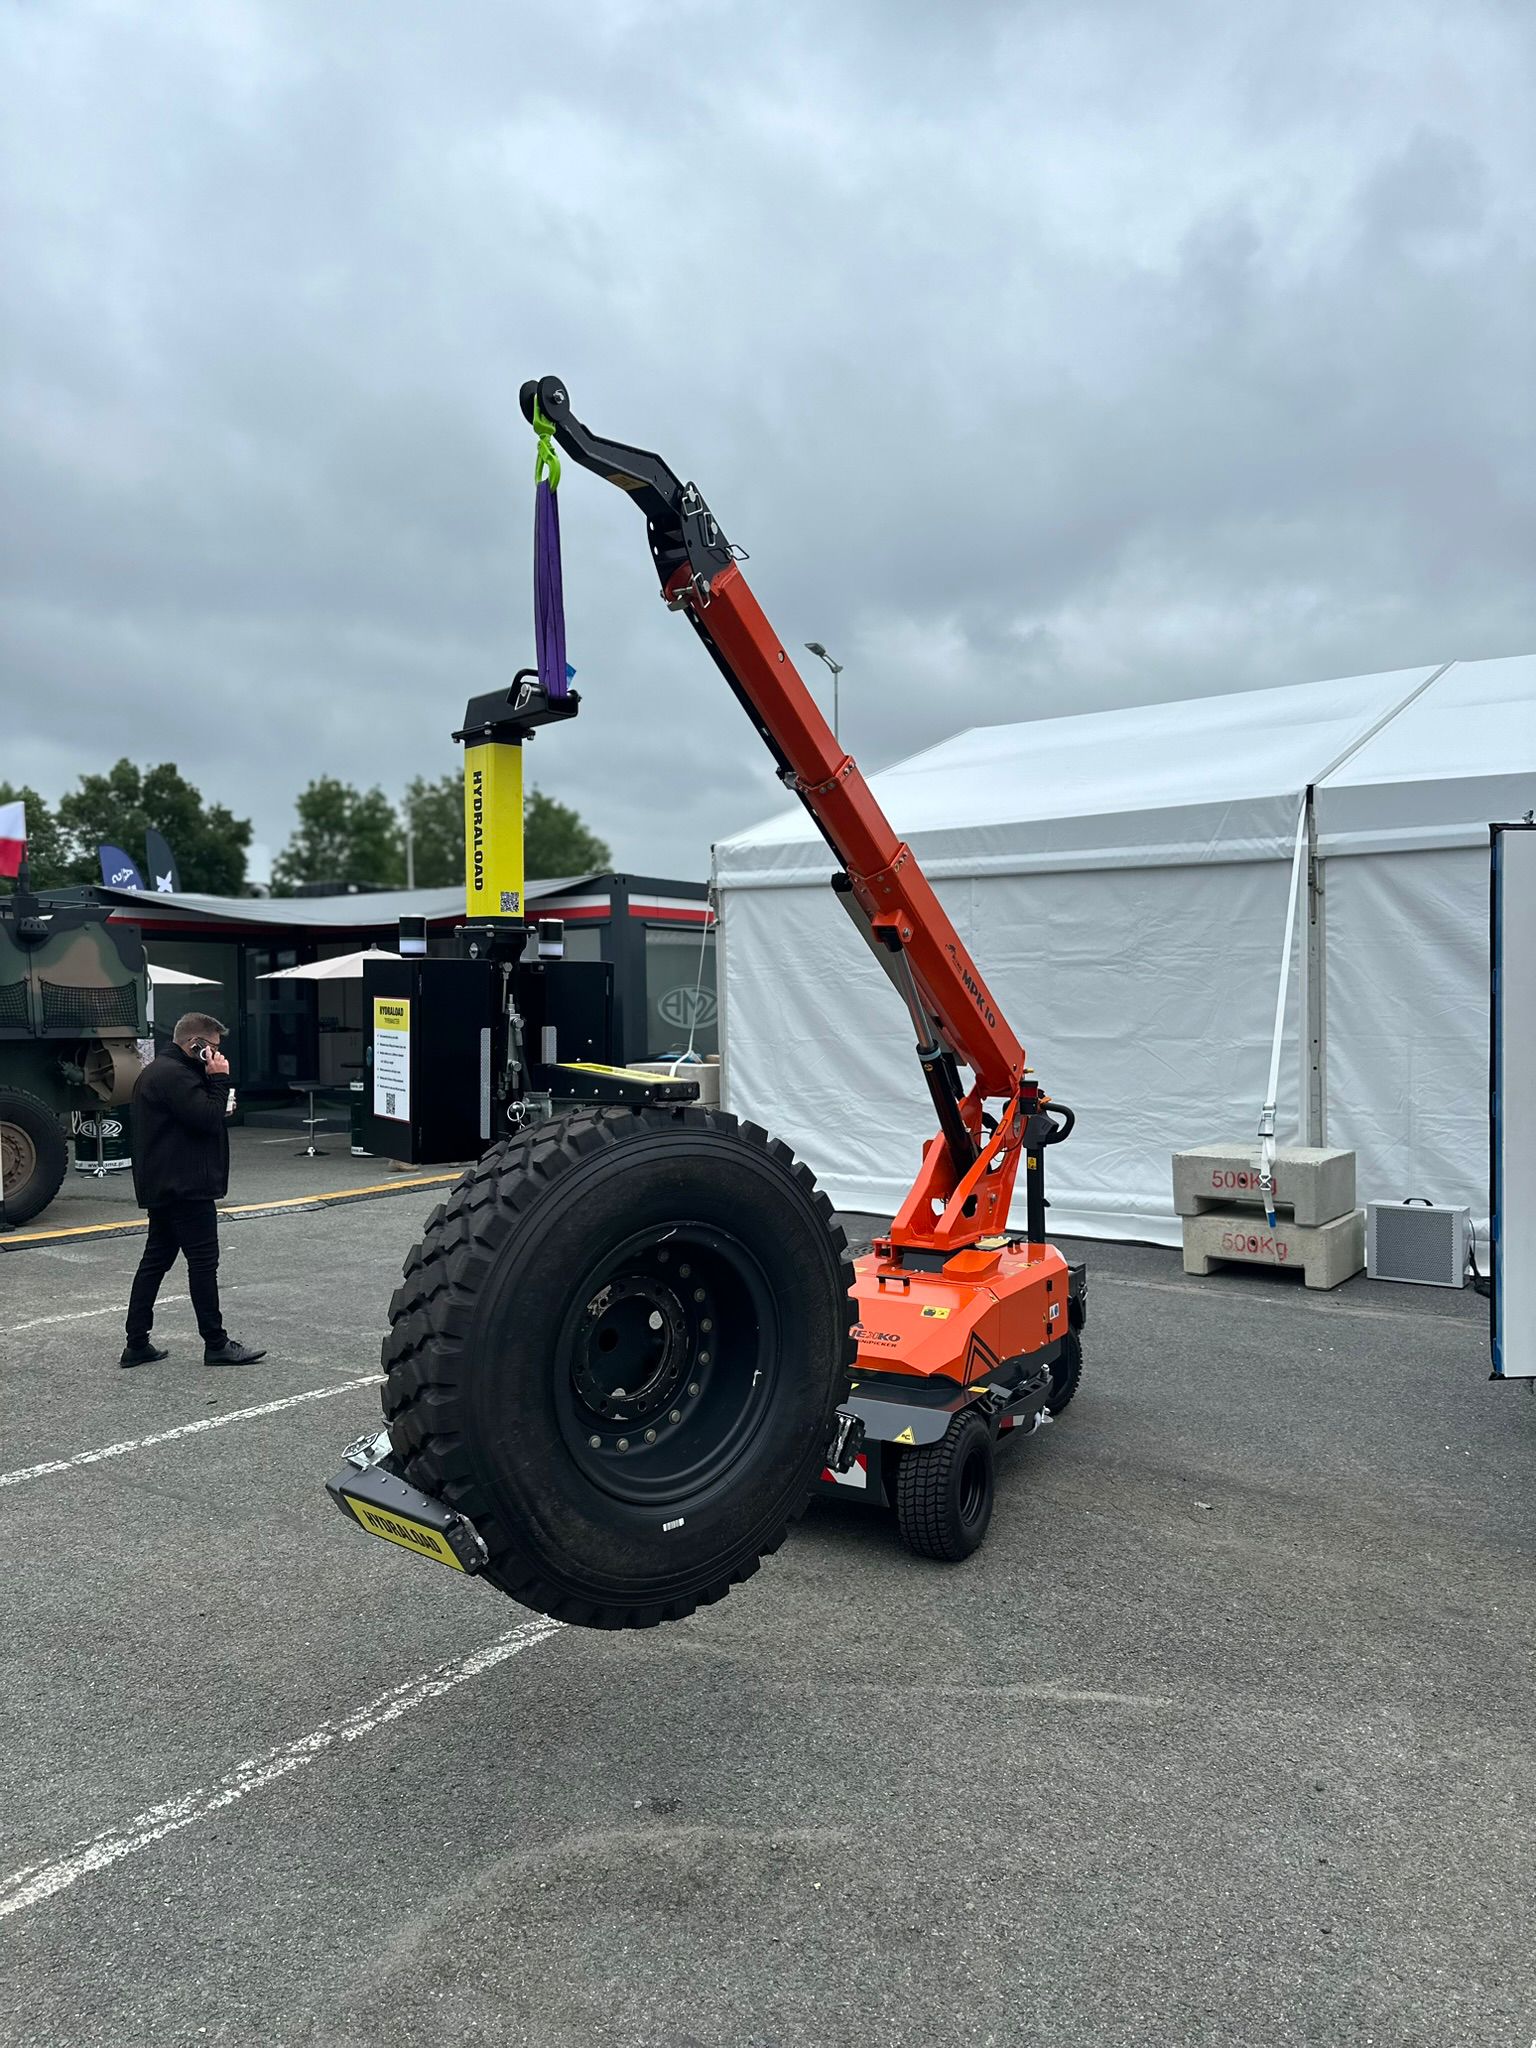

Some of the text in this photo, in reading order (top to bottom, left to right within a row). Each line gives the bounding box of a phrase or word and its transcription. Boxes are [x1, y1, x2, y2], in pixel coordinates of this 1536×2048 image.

[473, 770, 484, 891] HYDRALOAD
[962, 968, 996, 1029] MPK 10
[1222, 1232, 1288, 1262] 500Kg
[362, 1509, 443, 1555] HYDRALOAD
